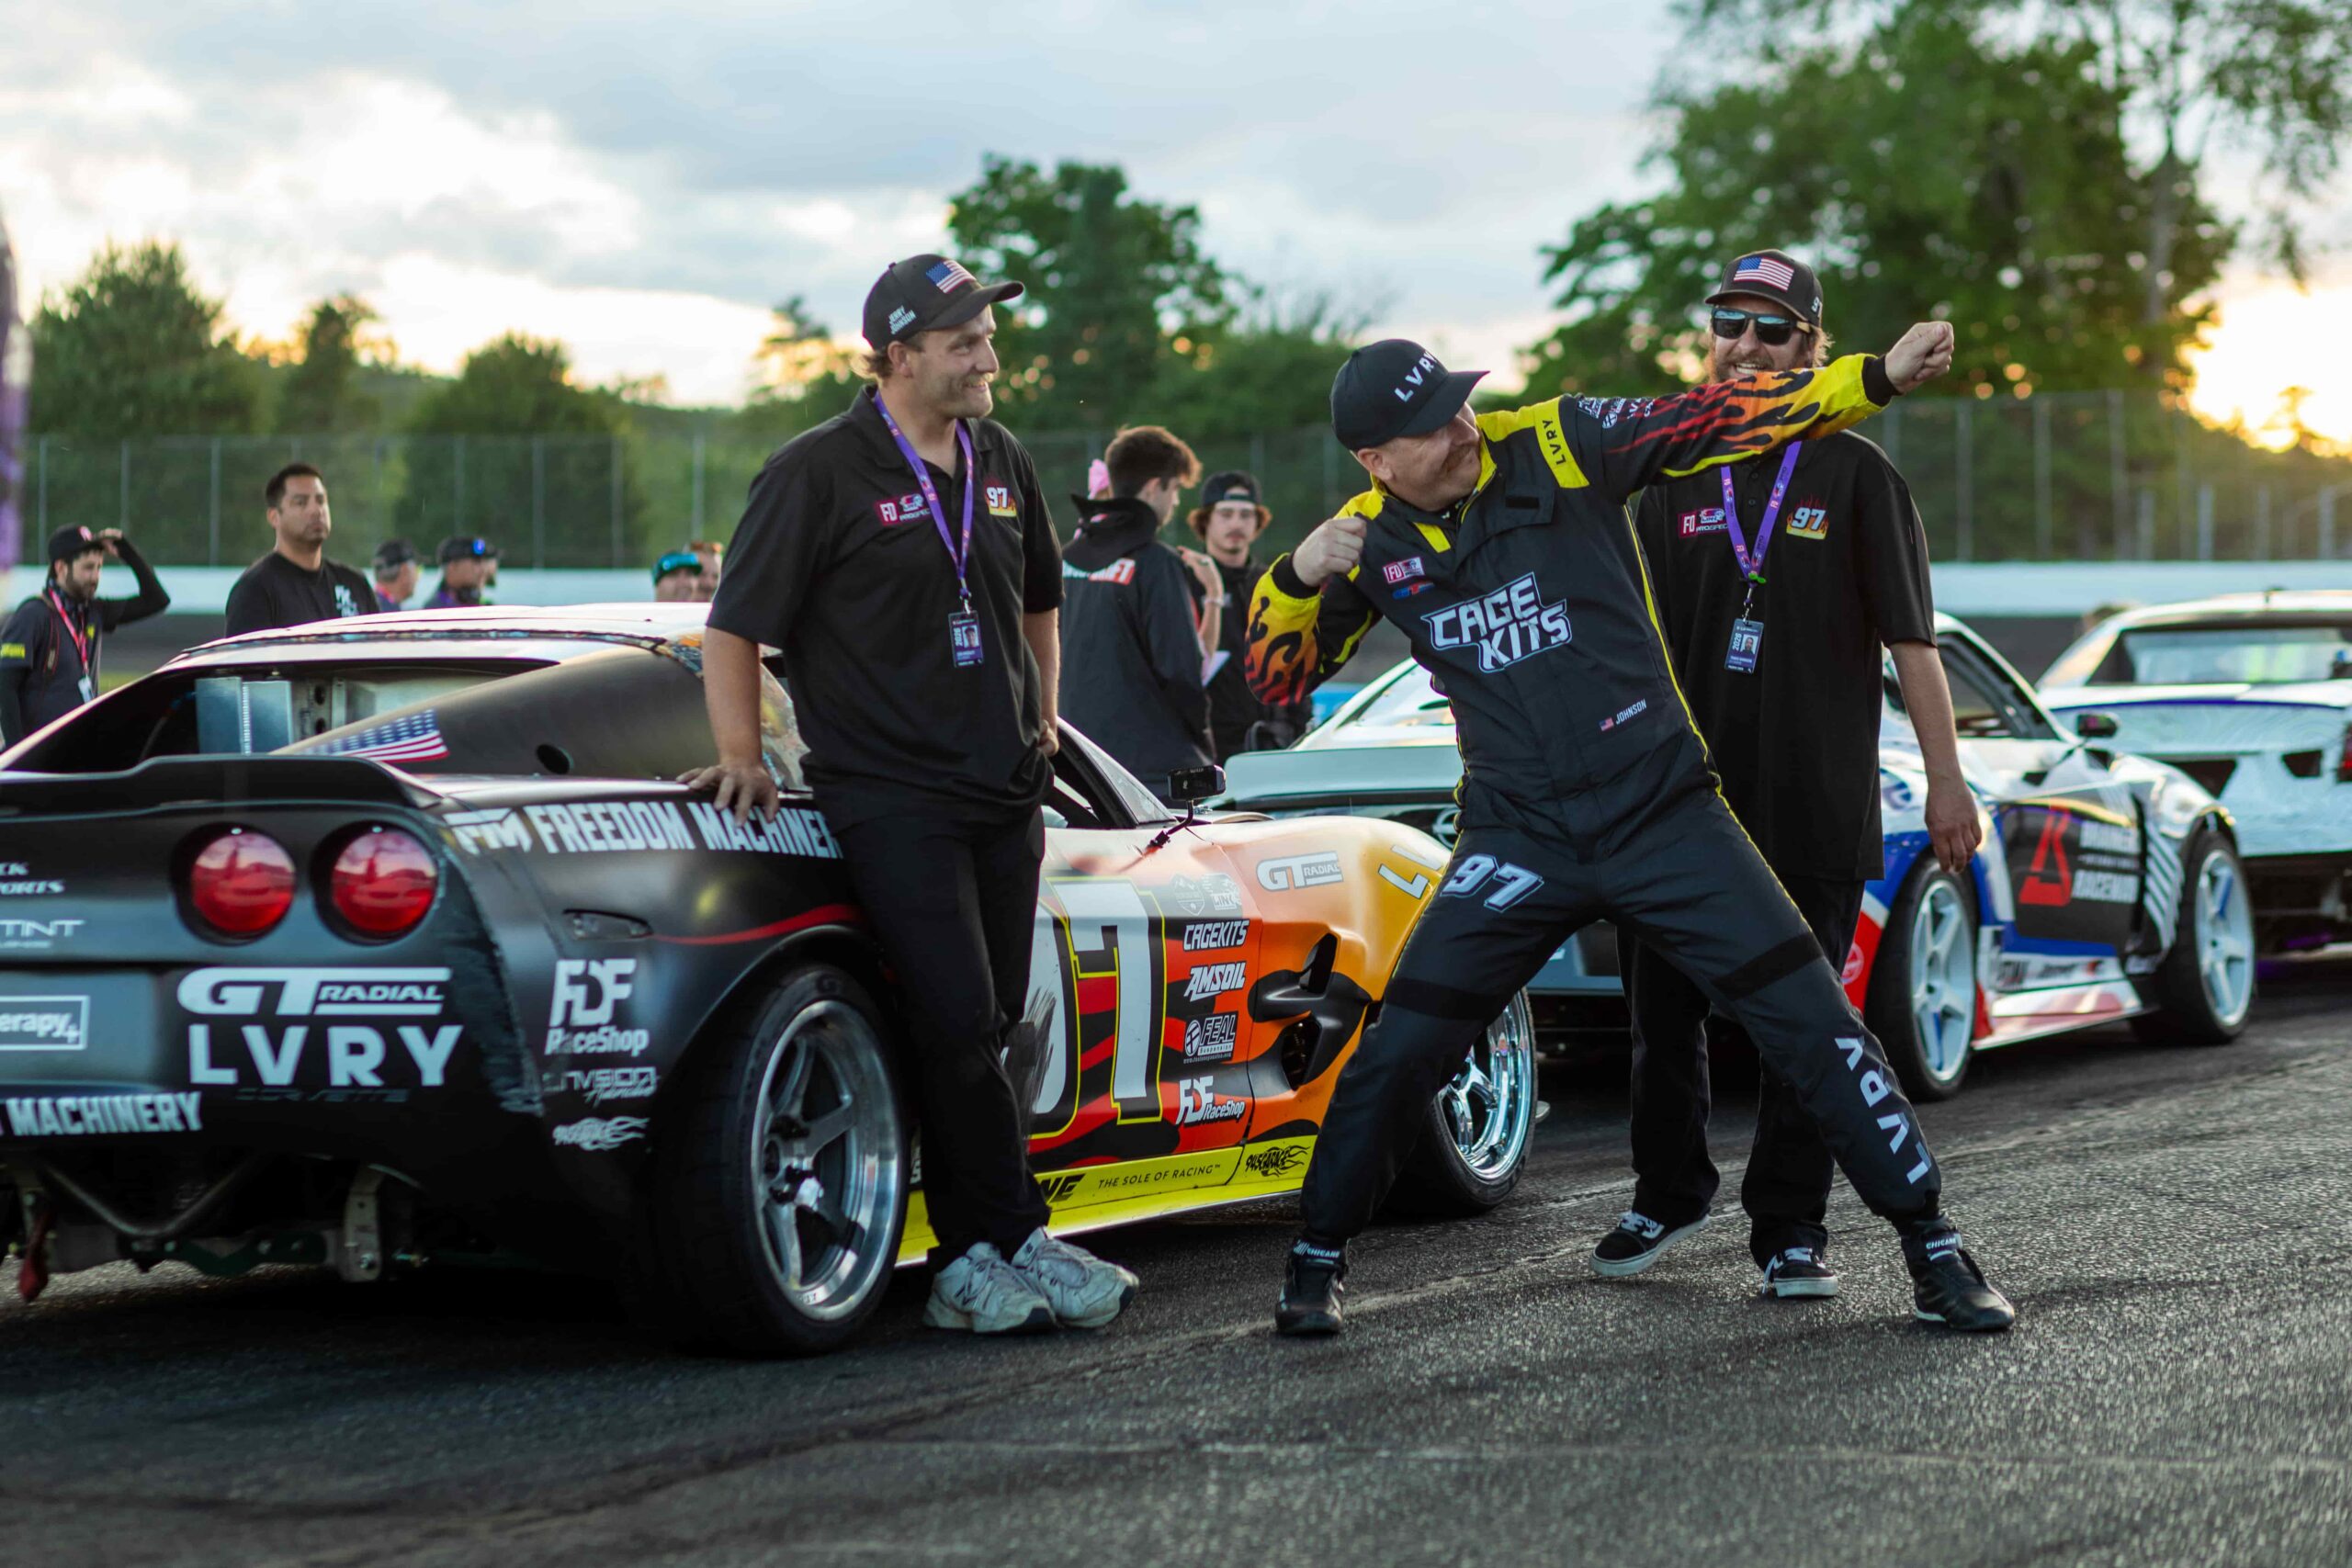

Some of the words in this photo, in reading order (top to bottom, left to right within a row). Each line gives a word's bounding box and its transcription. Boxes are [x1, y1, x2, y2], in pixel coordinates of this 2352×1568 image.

[1542, 420, 1566, 465] LVRY
[879, 502, 898, 522] FD
[986, 487, 1008, 508] 97
[1792, 506, 1826, 530] 97
[1683, 514, 1695, 534] FD
[1387, 564, 1403, 581] FD
[1430, 577, 1540, 647] CAGE
[1479, 604, 1570, 670] KITS
[1615, 698, 1646, 725] JOHNSON
[522, 801, 695, 854] FREEDOM
[1257, 851, 1343, 892] GT
[1304, 863, 1340, 877] RADIAL
[1439, 854, 1544, 913] 97
[1183, 919, 1250, 951] CAGEKITS
[177, 967, 451, 1015] GT
[318, 986, 445, 1001] RADIAL
[1183, 961, 1247, 1002] AMSOIL
[1200, 1014, 1237, 1046] FEAL
[188, 1024, 463, 1086] LVRY
[6, 1090, 202, 1136] MACHINERY
[1203, 1100, 1246, 1121] RaceShop
[1835, 1035, 1931, 1184] LVRY
[1099, 1178, 1120, 1189] THE
[1122, 1173, 1150, 1186] SOLE
[1154, 1171, 1170, 1181] OF
